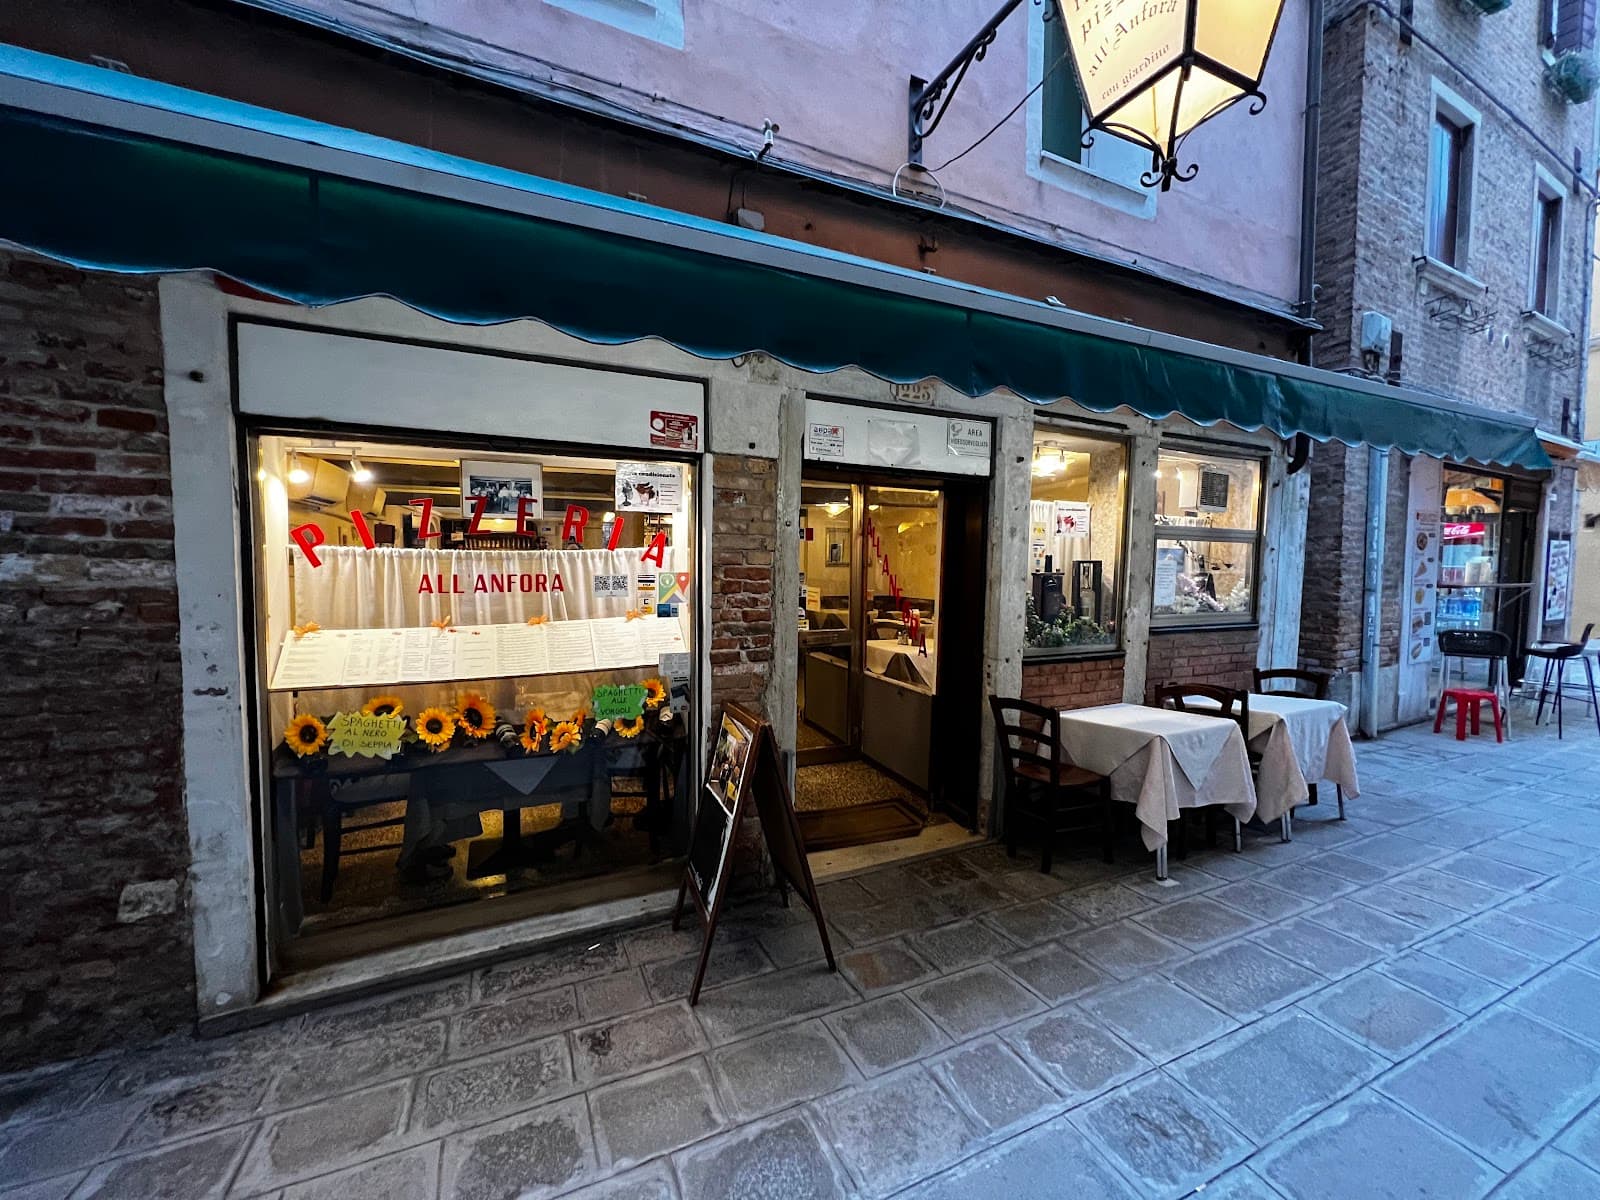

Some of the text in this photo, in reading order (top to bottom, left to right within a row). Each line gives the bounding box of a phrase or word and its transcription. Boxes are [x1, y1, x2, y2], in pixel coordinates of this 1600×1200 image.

[1122, 44, 1169, 88] giardino
[289, 496, 666, 569] PIZZERIA
[343, 717, 401, 730] SPAGHETTI
[344, 728, 388, 738] AL NERO
[342, 739, 392, 749] DI SEPPIA
